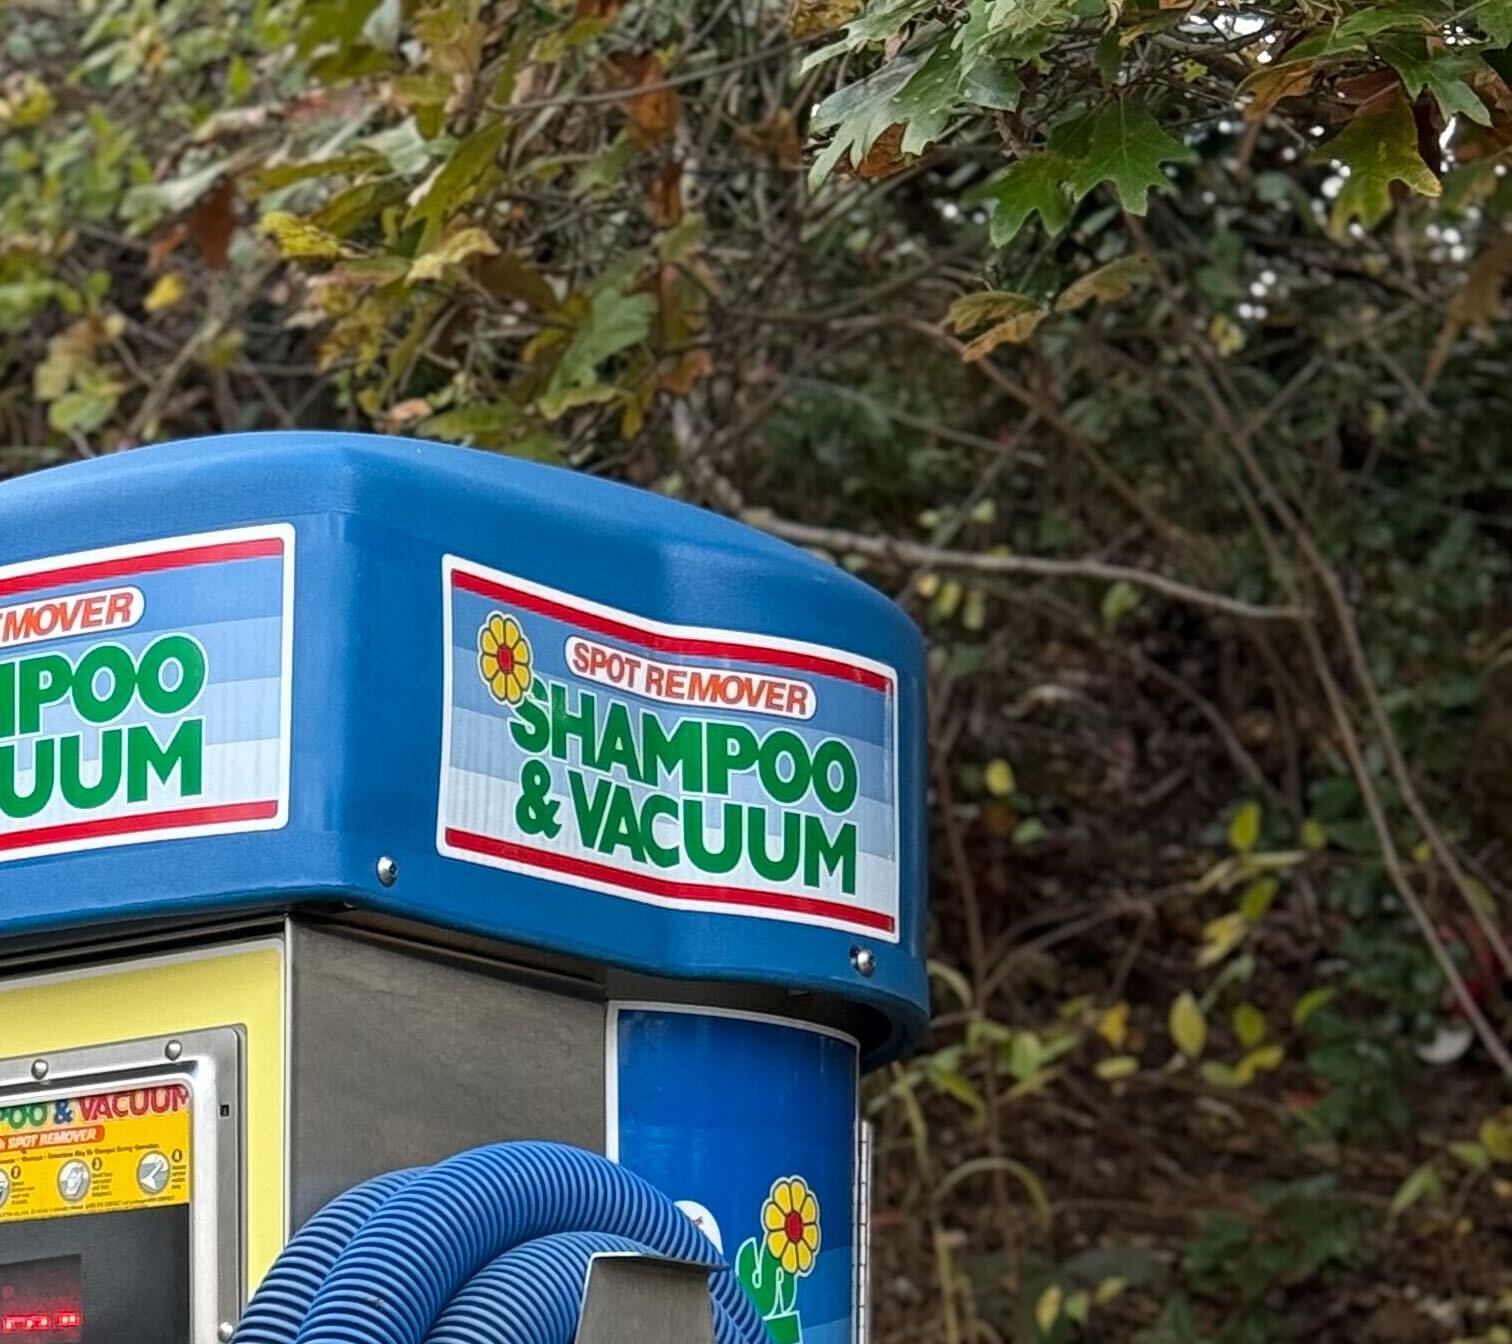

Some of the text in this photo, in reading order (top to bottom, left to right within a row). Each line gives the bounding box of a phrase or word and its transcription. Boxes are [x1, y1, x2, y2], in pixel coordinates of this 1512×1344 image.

[573, 643, 808, 715] SPOT REMOVER
[509, 677, 858, 813] SHAMPOO
[515, 759, 856, 894] & VACUUM
[7, 1133, 38, 1149] SPOT
[40, 1128, 97, 1145] REMOVER
[54, 1100, 73, 1124] &
